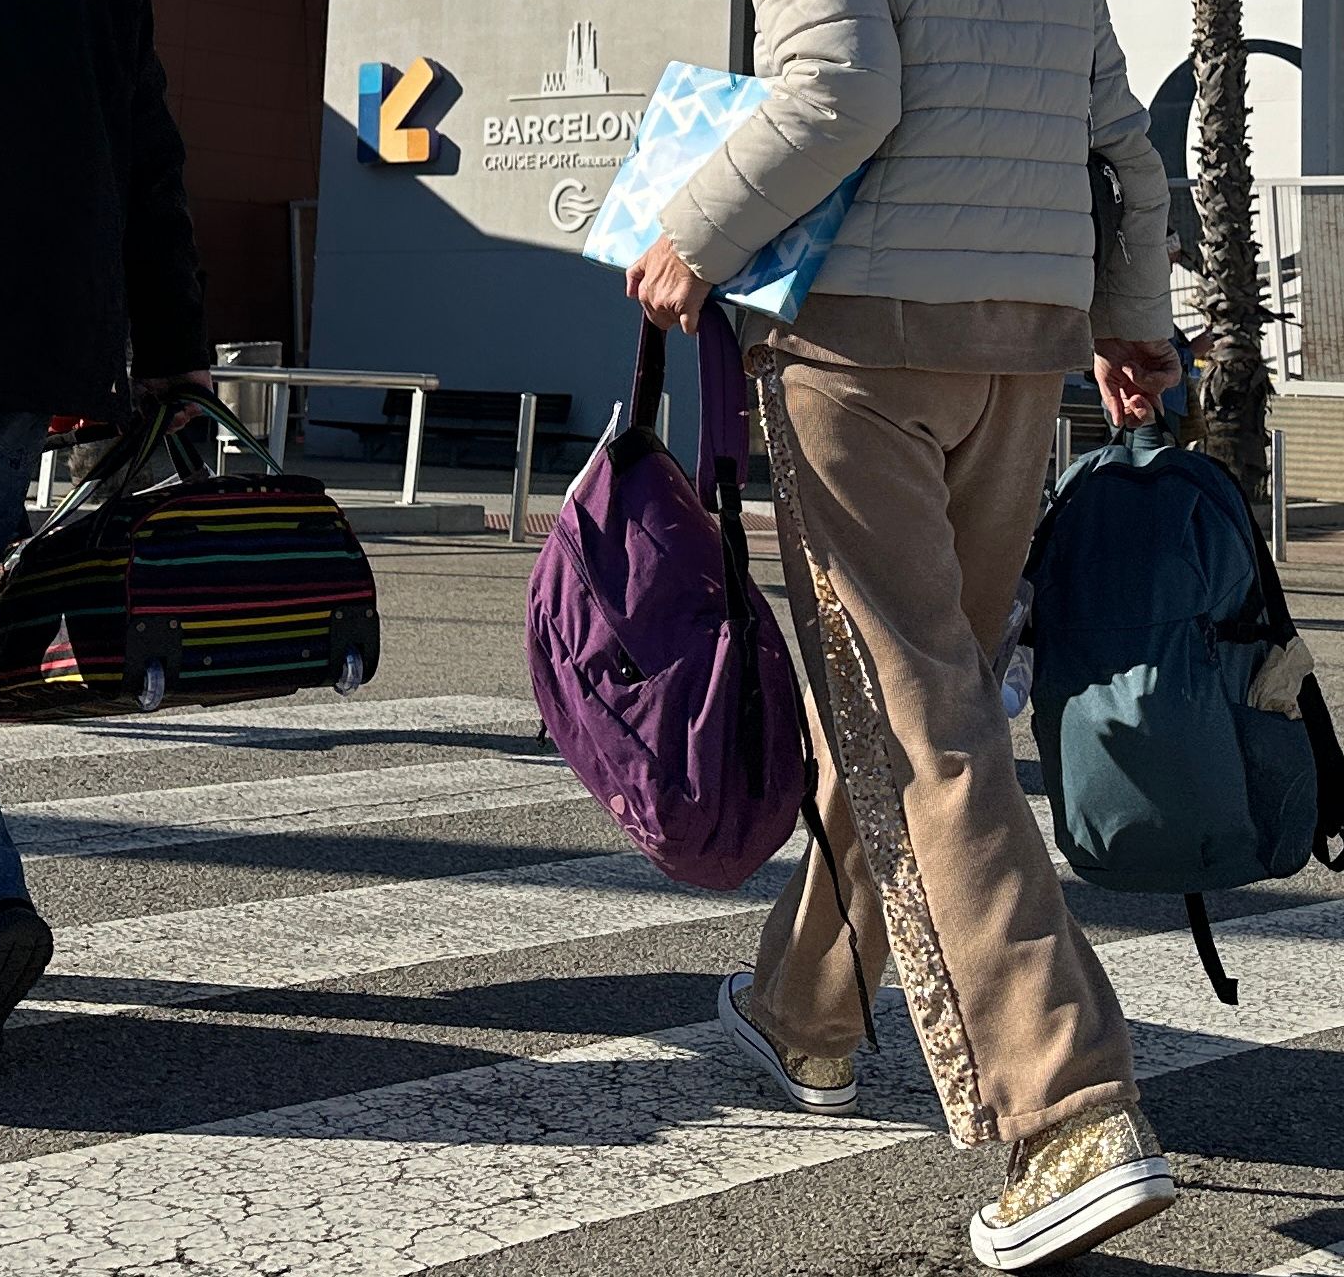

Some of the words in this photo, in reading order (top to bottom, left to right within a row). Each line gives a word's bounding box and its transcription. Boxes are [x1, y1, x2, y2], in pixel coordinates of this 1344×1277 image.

[483, 110, 644, 146] BARCELON
[483, 152, 537, 172] CRUISE
[539, 149, 580, 170] PORT
